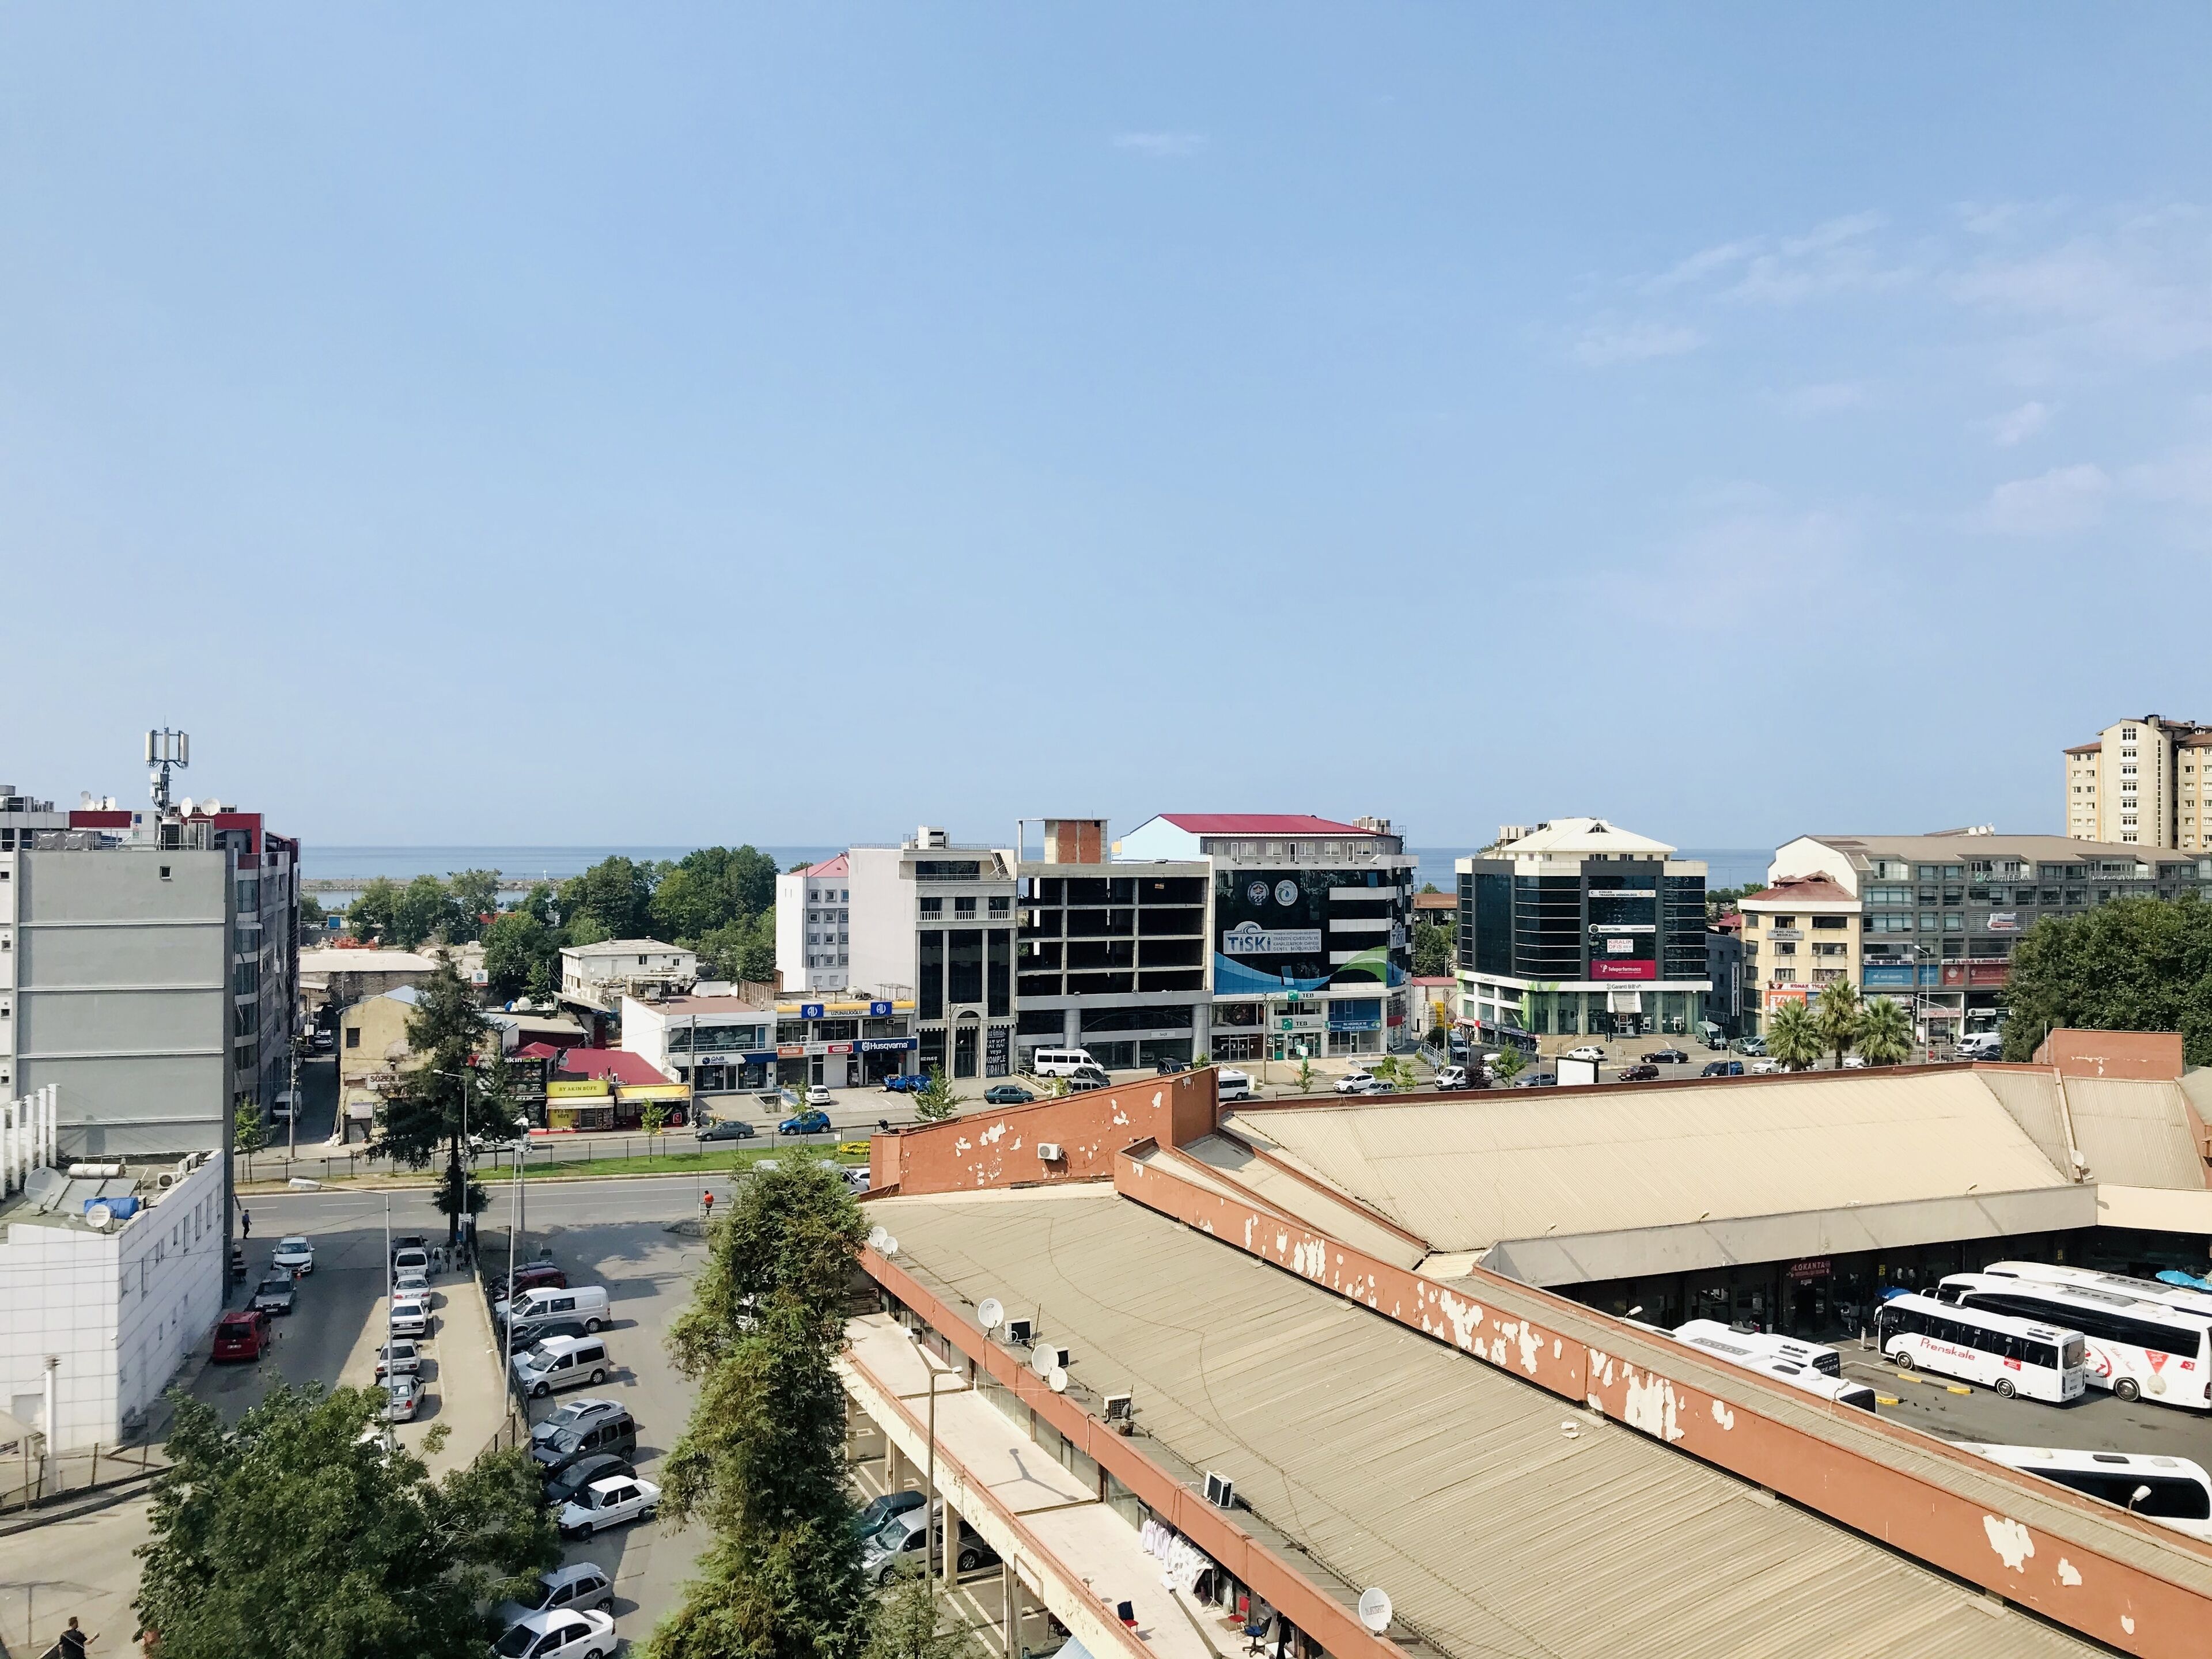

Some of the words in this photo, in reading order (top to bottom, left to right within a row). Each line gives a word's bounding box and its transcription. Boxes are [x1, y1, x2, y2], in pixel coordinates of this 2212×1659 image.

[870, 1041, 908, 1051] Husqvarna
[1794, 1262, 1825, 1271] LOKANTA
[1920, 1337, 1975, 1361] Prenskale
